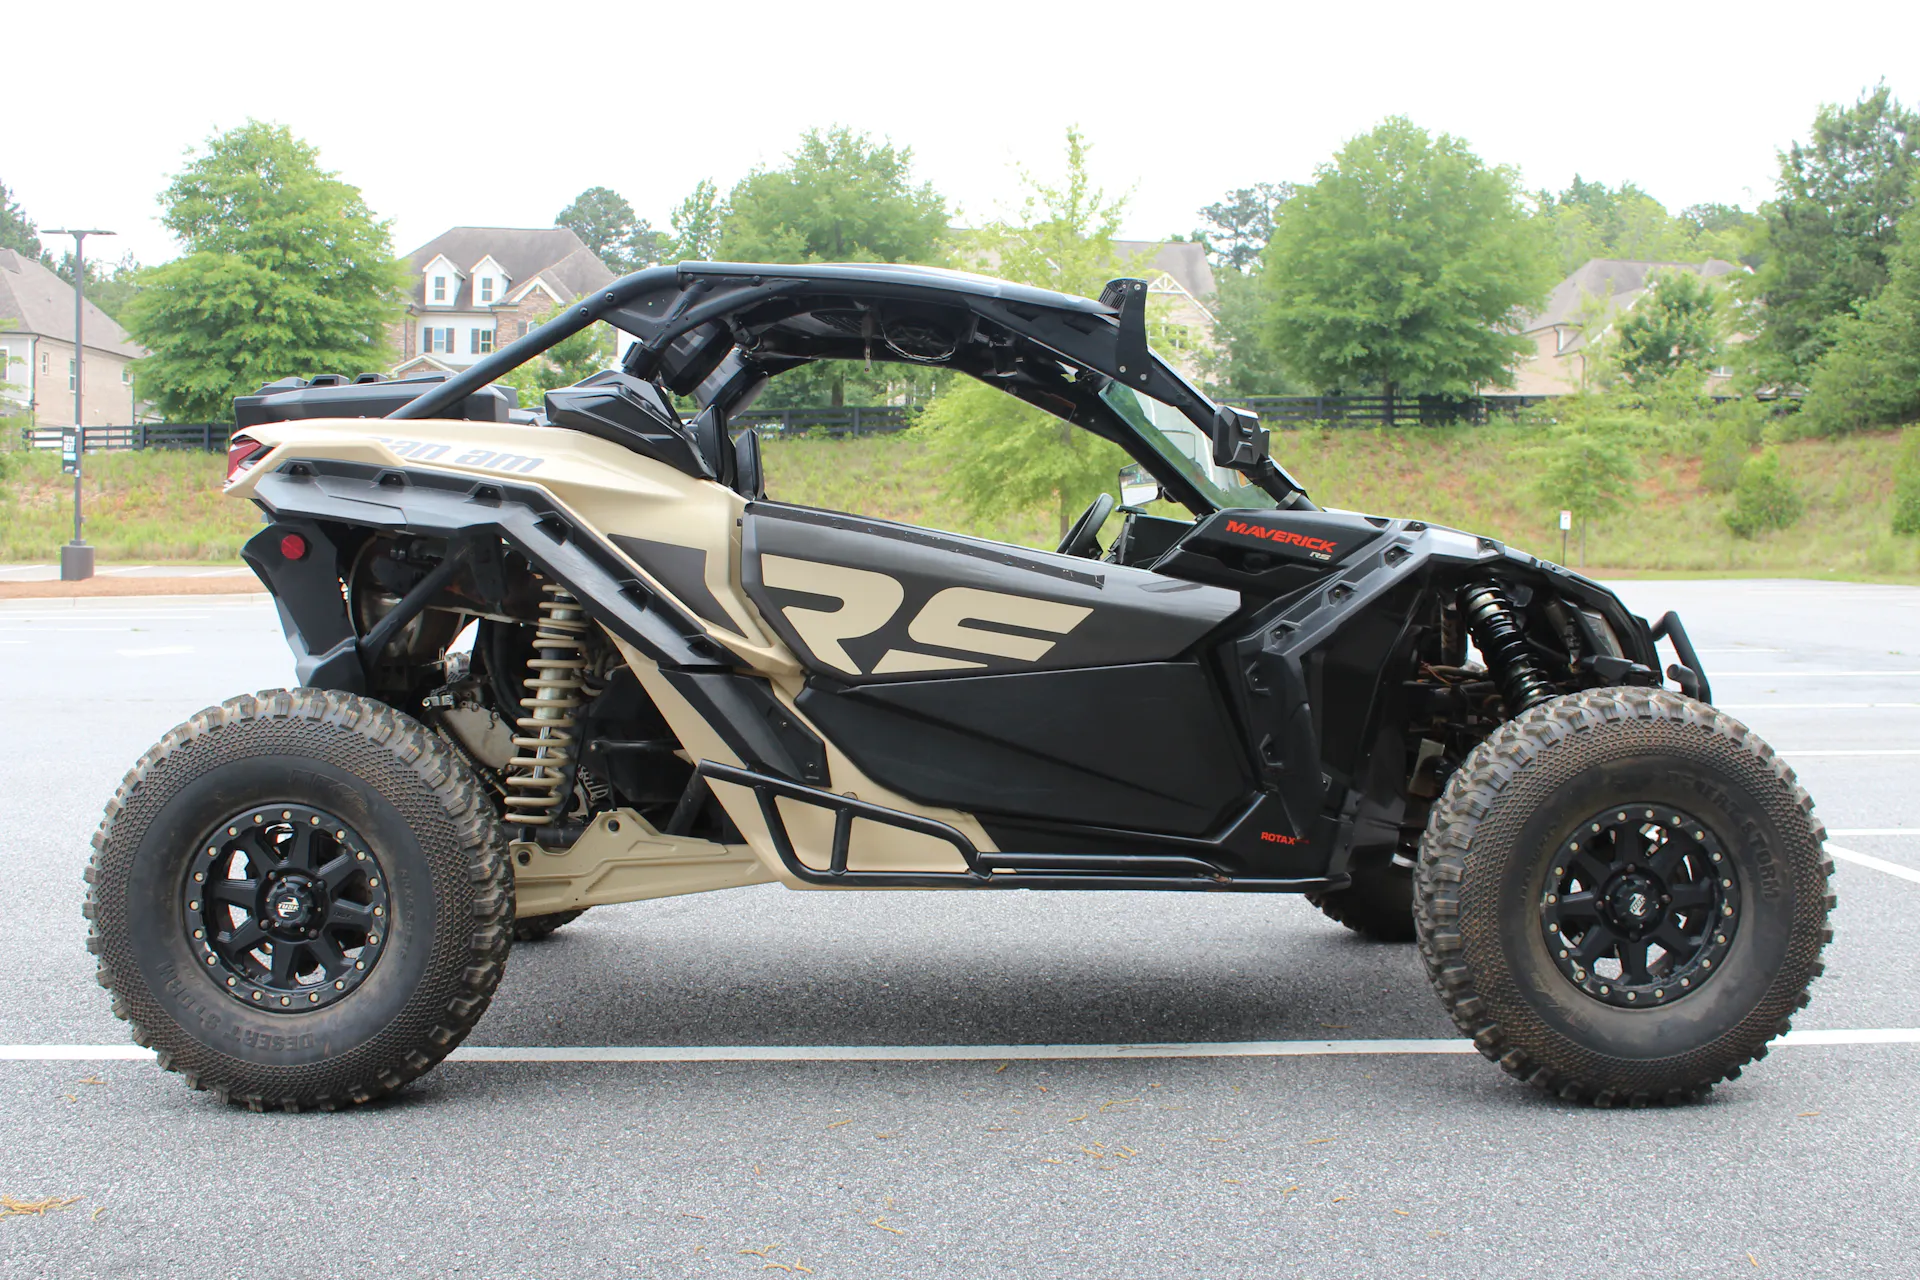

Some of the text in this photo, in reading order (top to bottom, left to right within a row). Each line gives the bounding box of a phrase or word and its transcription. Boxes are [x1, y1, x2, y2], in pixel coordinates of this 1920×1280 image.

[1225, 519, 1338, 553] MAVERICK
[1309, 551, 1332, 560] RS
[760, 553, 1095, 676] RS
[1260, 831, 1296, 846] ROTAX
[1741, 820, 1782, 900] STORM
[155, 958, 222, 1030] STORM
[222, 1025, 315, 1052] DESERT
